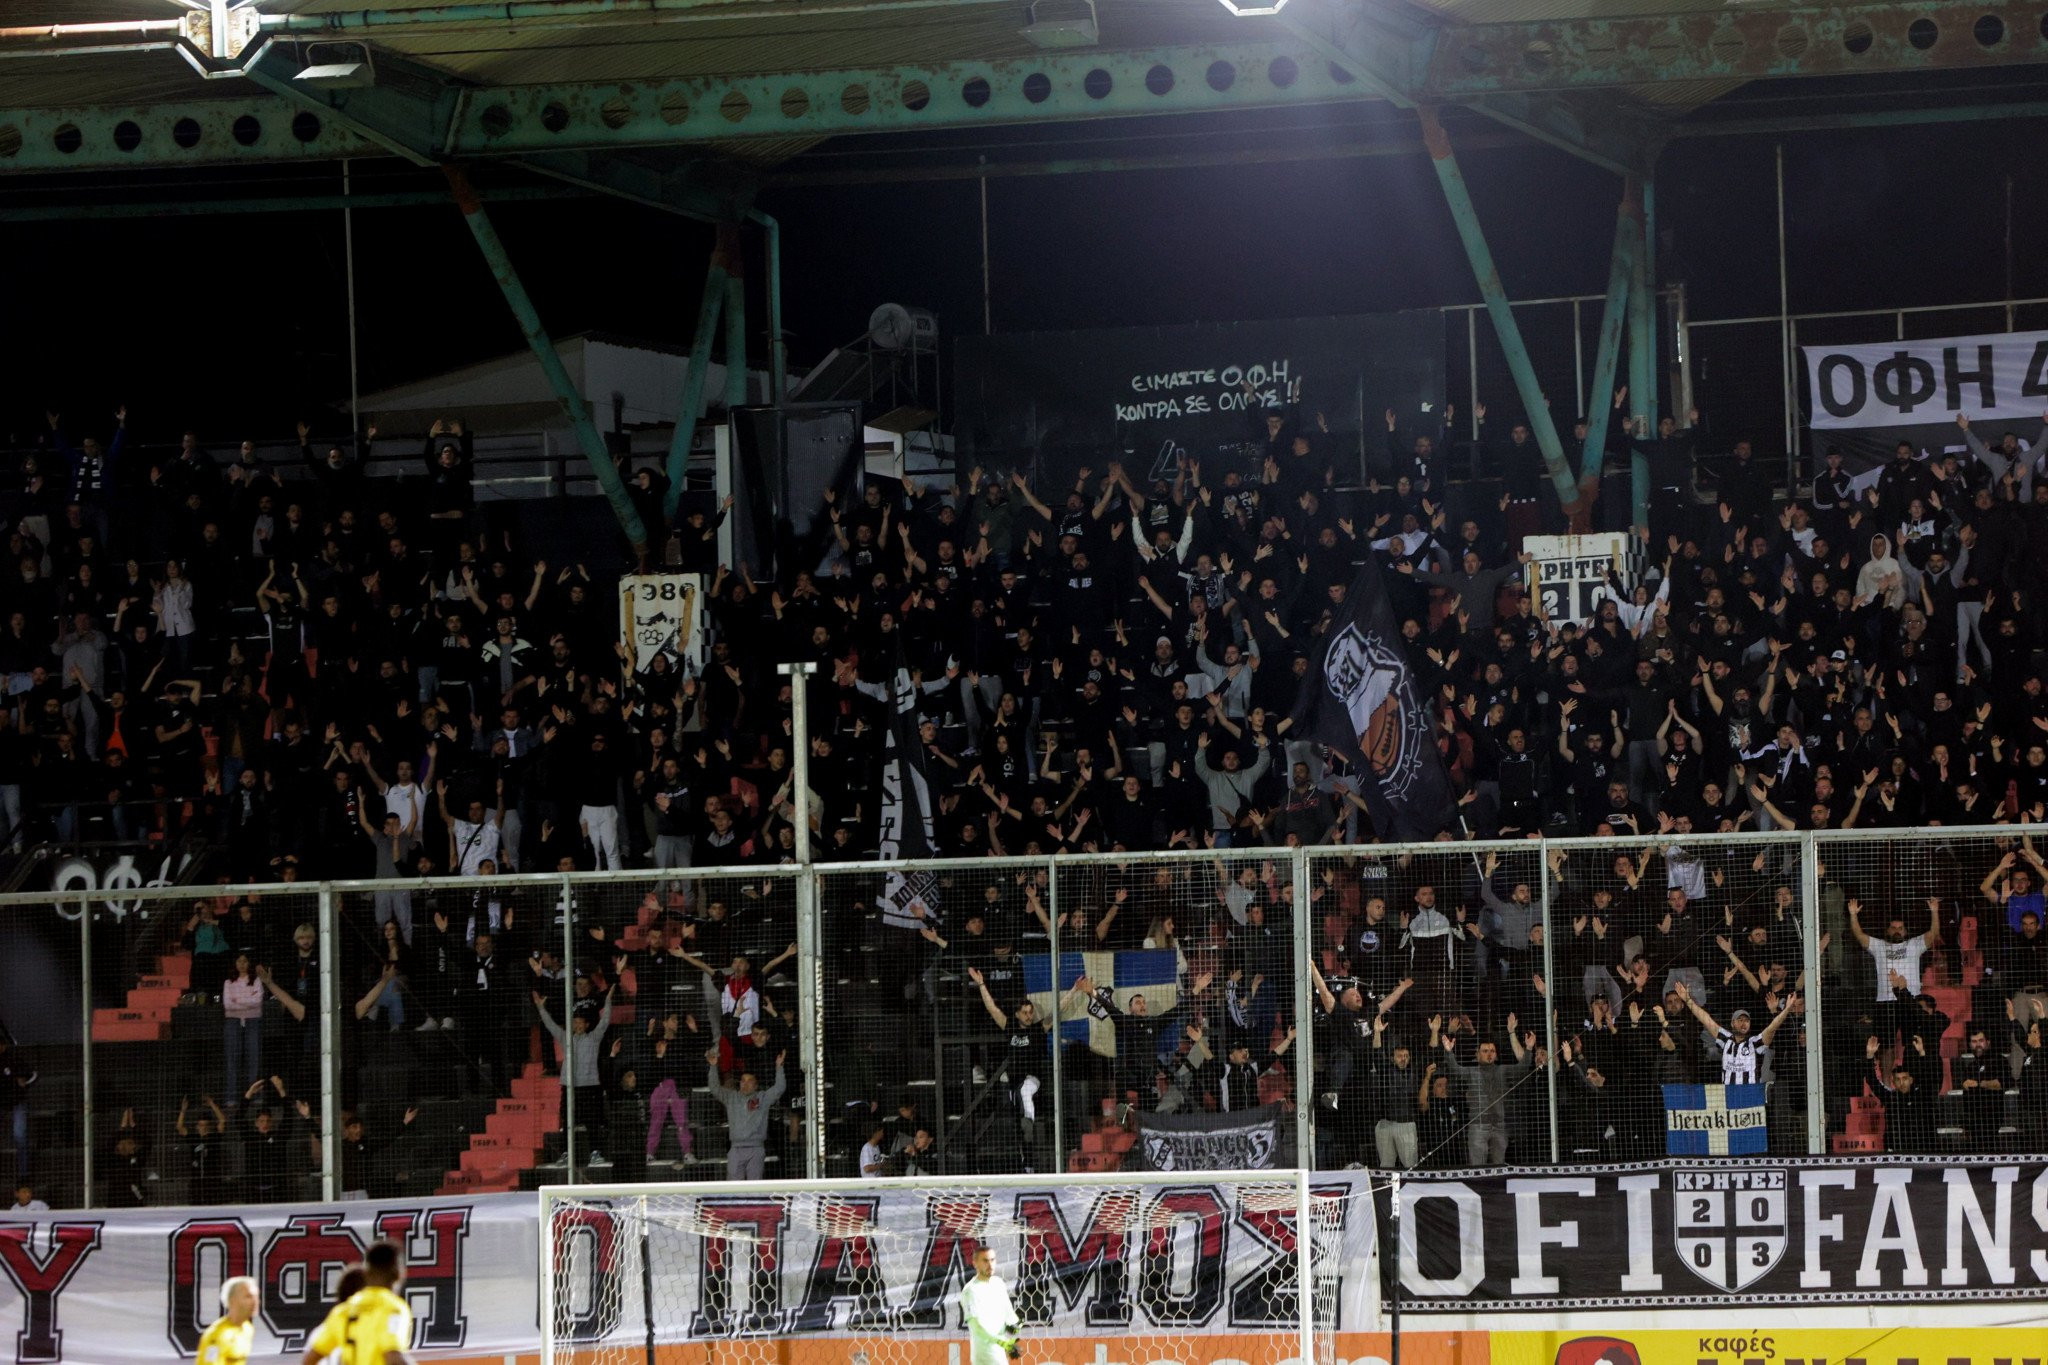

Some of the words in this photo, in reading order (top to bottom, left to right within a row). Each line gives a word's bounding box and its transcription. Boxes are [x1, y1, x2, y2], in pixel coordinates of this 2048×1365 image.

[1131, 369, 1216, 392] ΕΙΜΑΣΤΕ
[1818, 344, 1996, 418] ΟΦΗ
[1115, 398, 1181, 421] ΚΟΝΤΡΑ
[1184, 395, 1211, 413] ΣΕ
[1676, 1172, 1784, 1190] ΚΡΗΤΕΣ
[1692, 1198, 1711, 1222] 2
[1751, 1197, 1769, 1222] 0
[1391, 1174, 1663, 1296] OFI
[1694, 1243, 1712, 1268] 0
[1752, 1242, 1770, 1267] 3
[168, 1205, 473, 1358] ΟΦΗ
[687, 1181, 1352, 1340] ΠΑΛΜΟΣ
[1698, 1328, 1775, 1358] καφές
